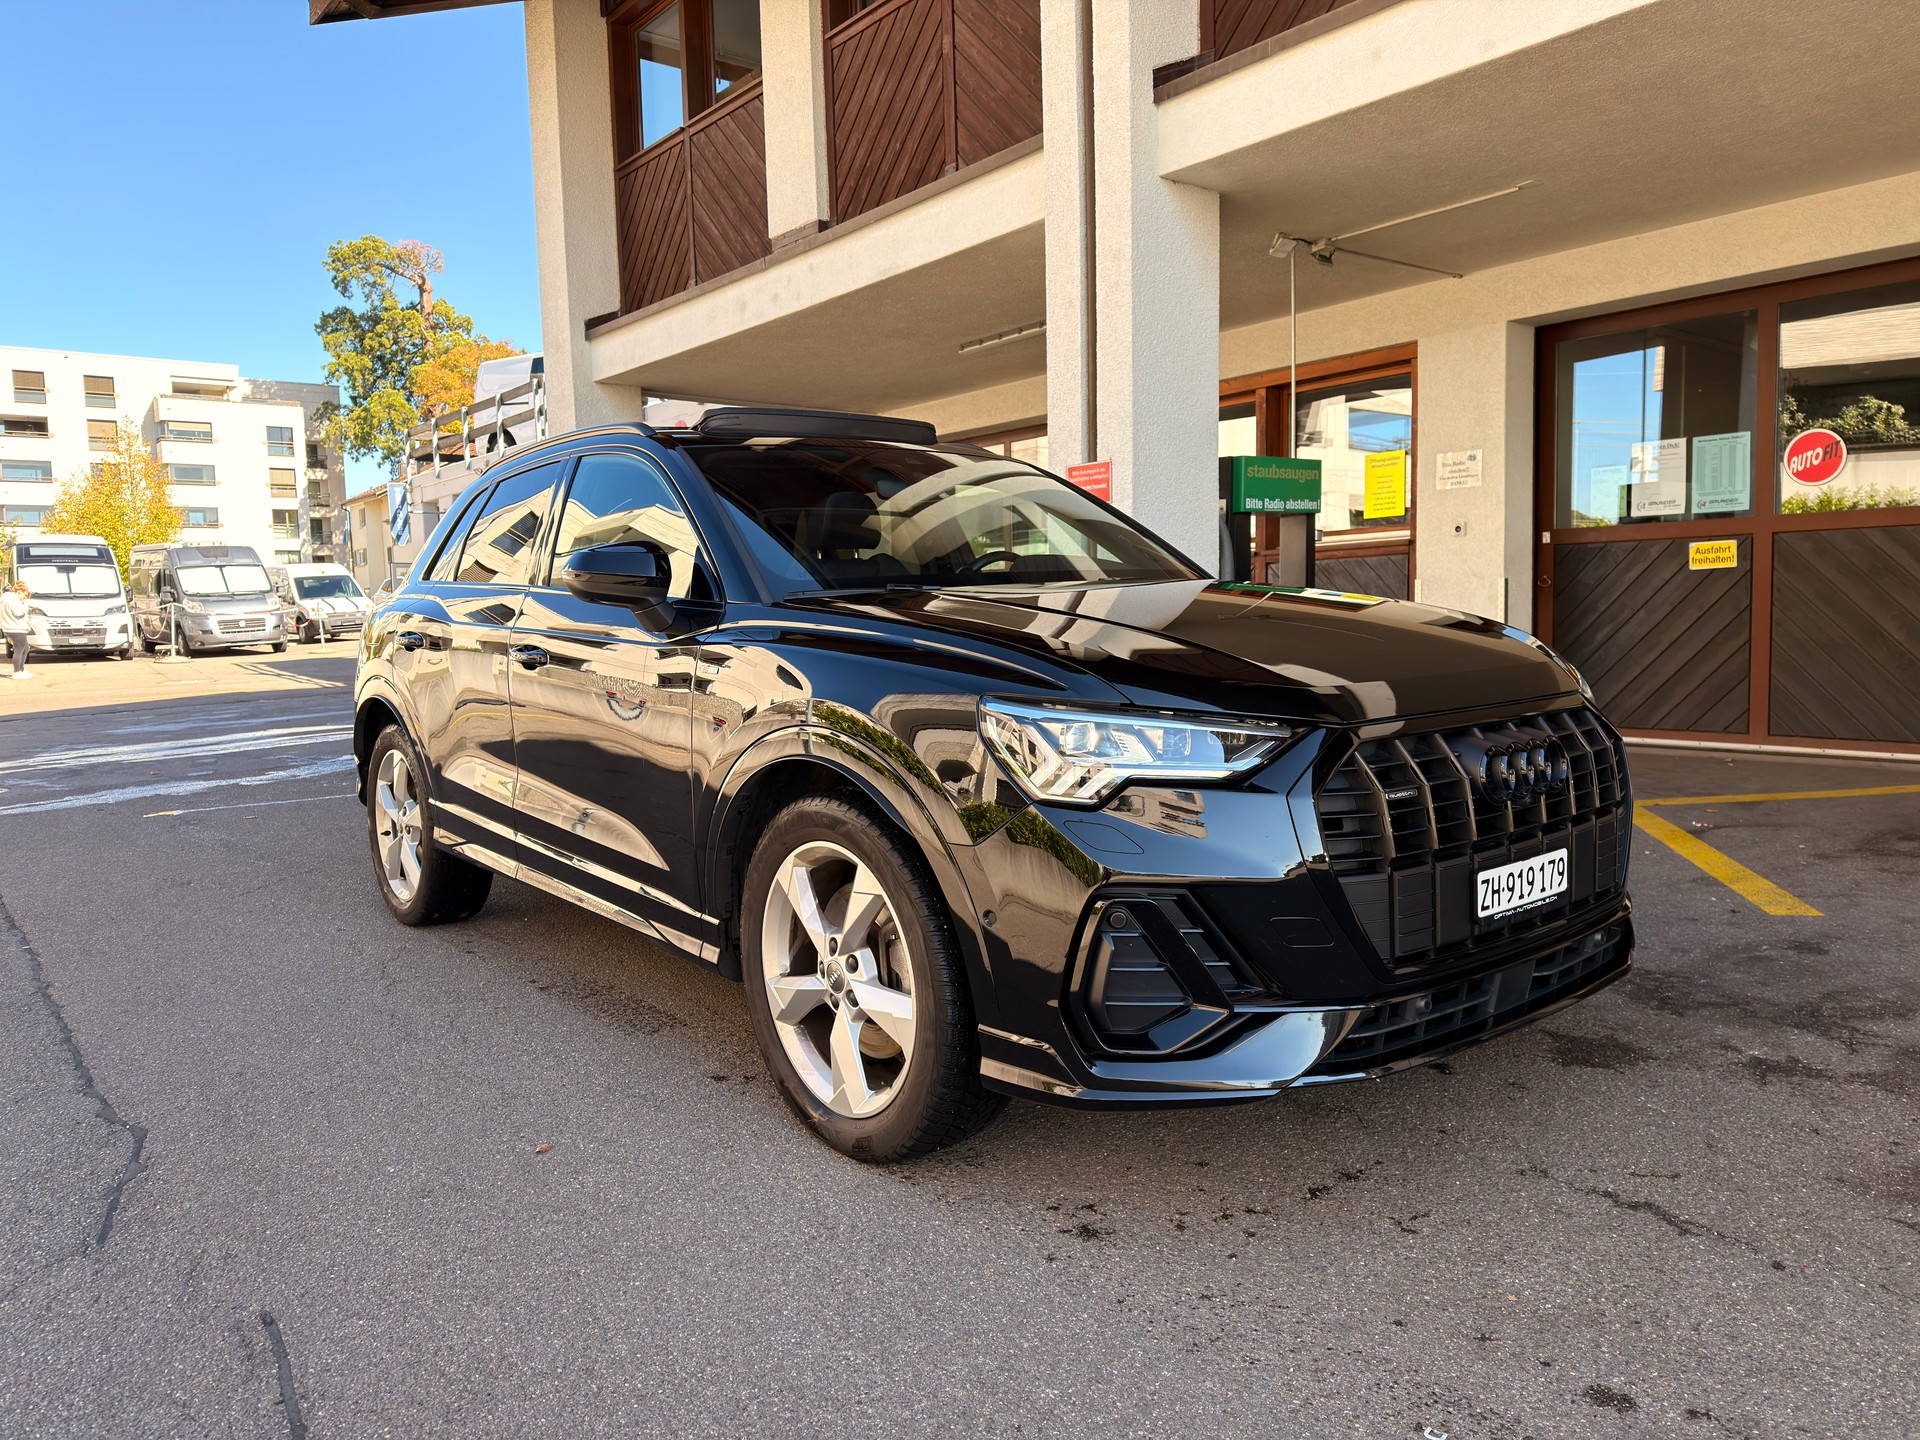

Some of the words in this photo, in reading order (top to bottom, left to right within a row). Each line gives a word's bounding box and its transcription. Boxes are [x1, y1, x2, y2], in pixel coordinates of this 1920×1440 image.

[1247, 464, 1319, 483] staubsaugen
[1245, 498, 1263, 509] Bitte
[1264, 498, 1285, 510] Radio
[1285, 499, 1320, 510] abstellen!
[1694, 545, 1732, 556] Ausfahrt
[1691, 554, 1735, 565] freihalten!
